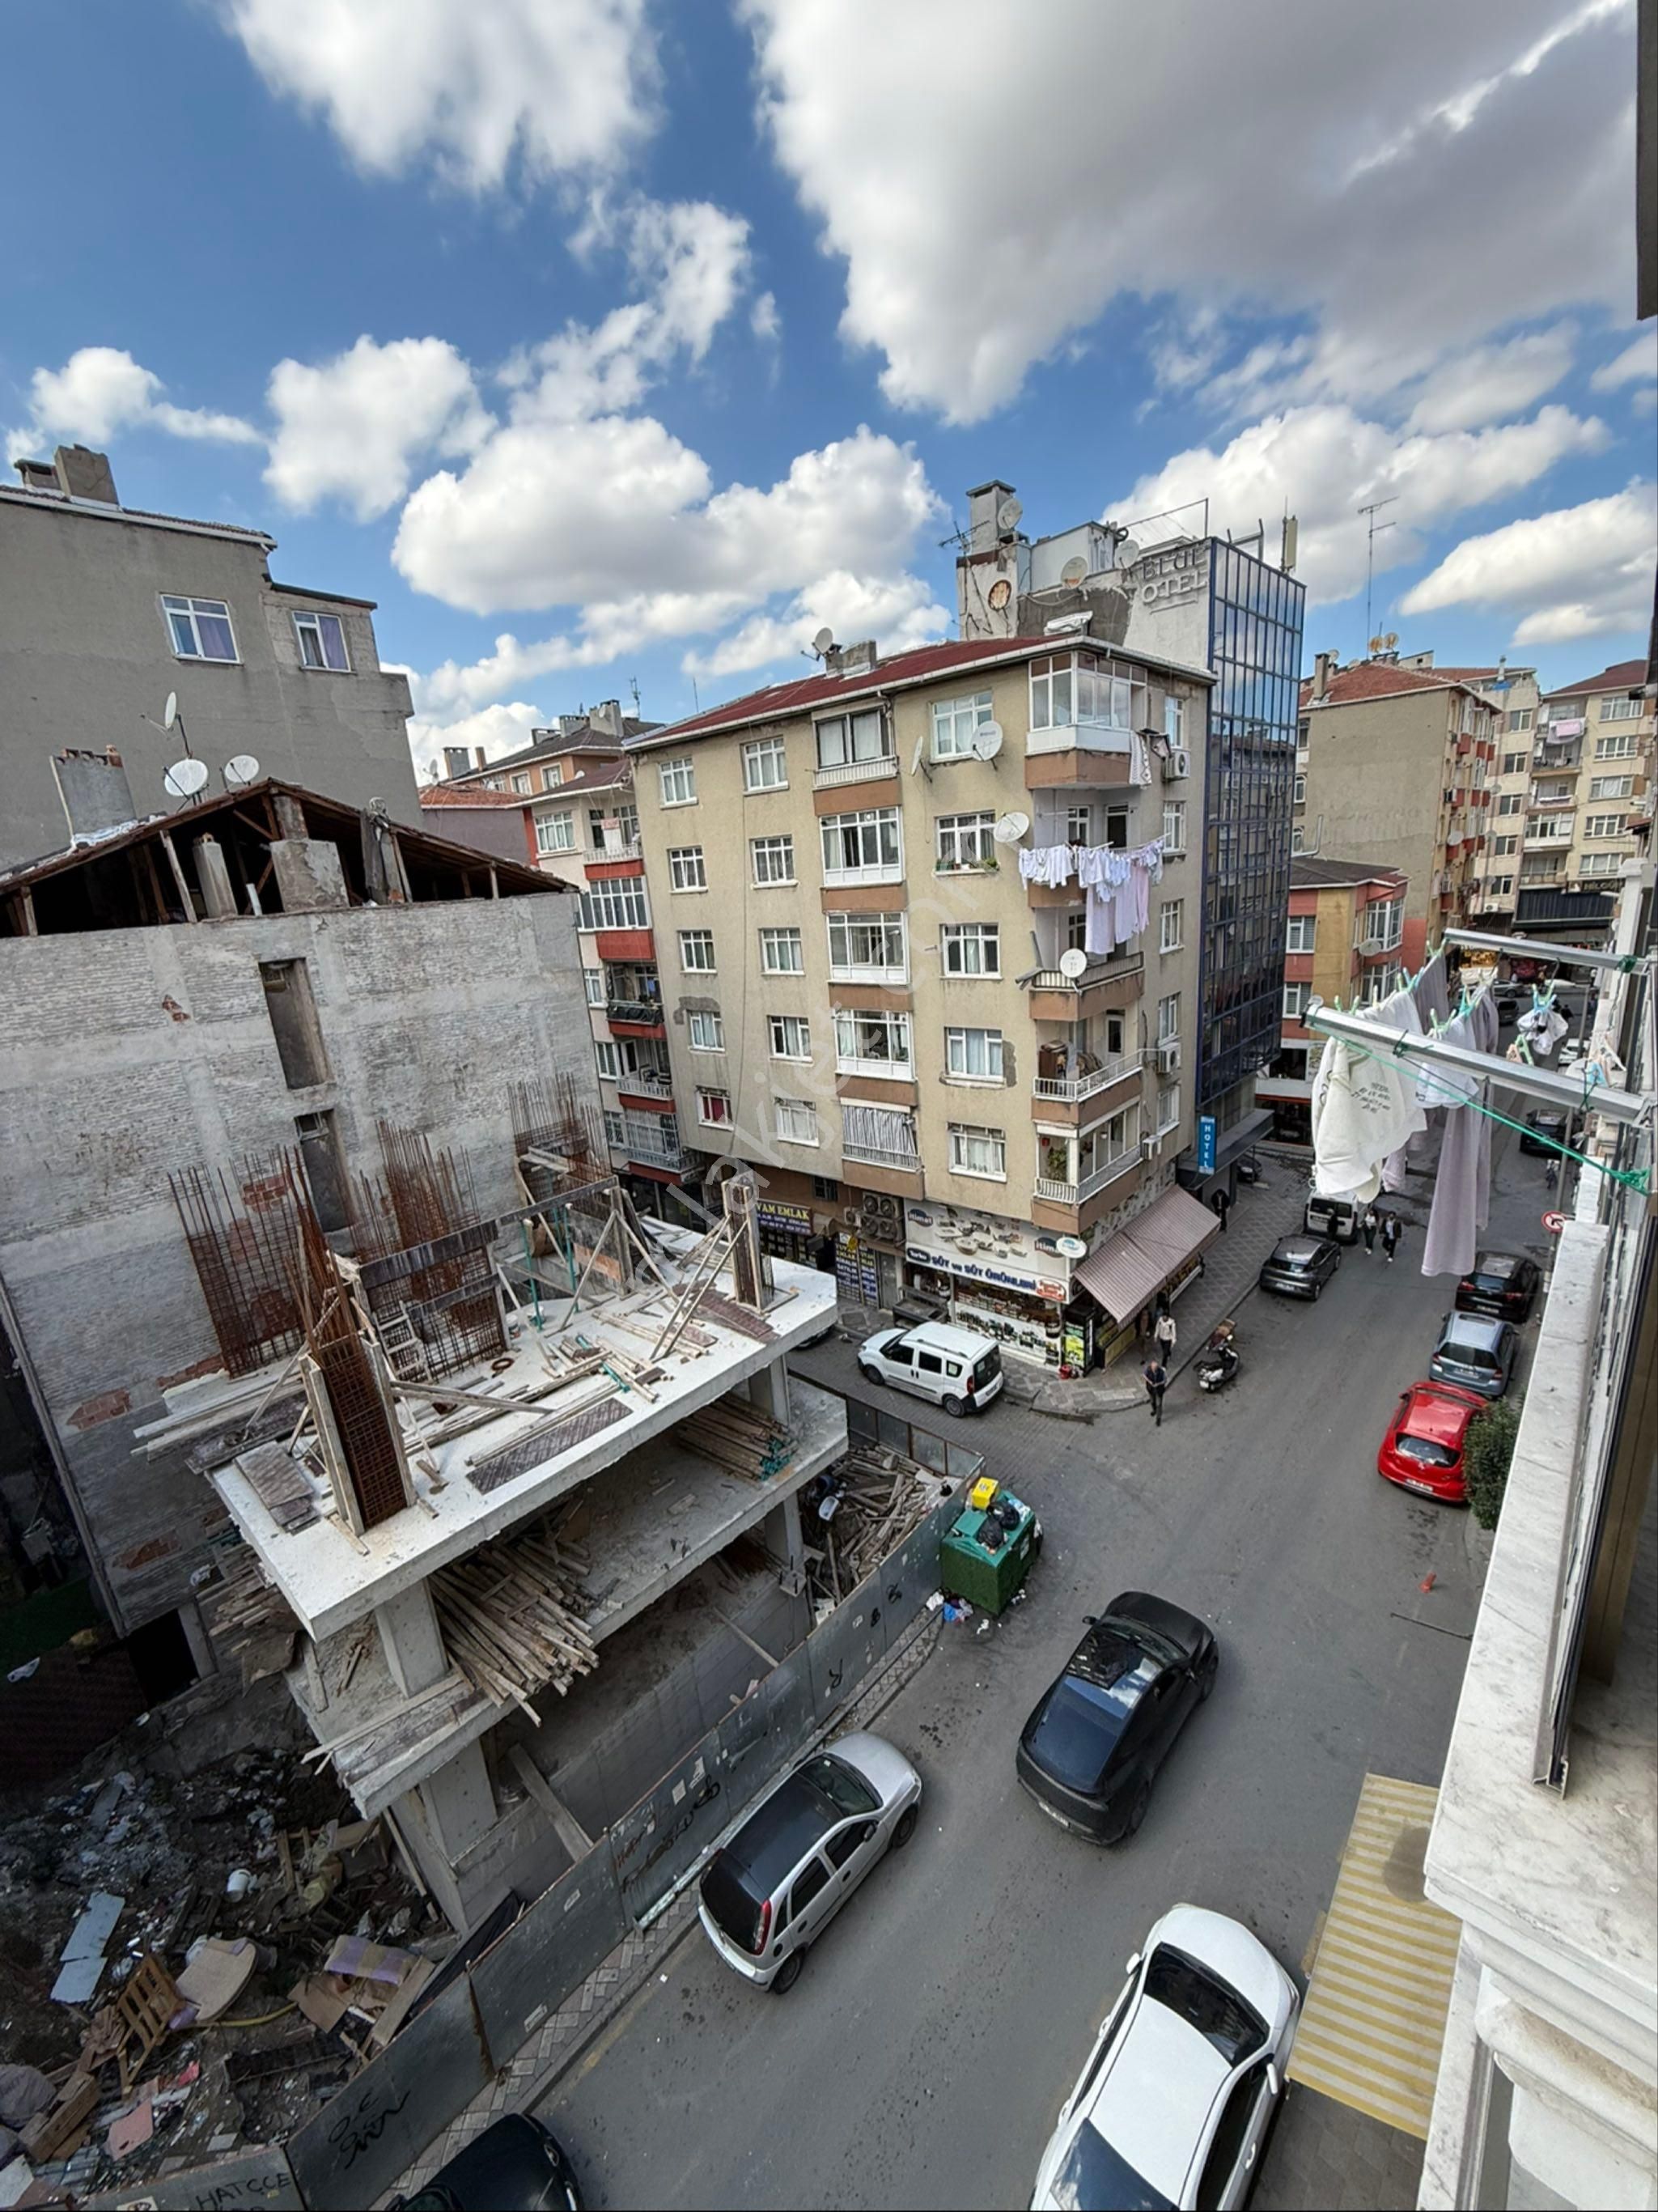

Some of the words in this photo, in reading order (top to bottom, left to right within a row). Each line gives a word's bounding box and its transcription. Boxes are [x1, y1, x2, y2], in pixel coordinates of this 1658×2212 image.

[1142, 570, 1206, 605] OTEL
[1203, 1124, 1212, 1168] HOTEL
[777, 1205, 809, 1221] EMLAK
[931, 1255, 949, 1268] SÜT
[964, 1263, 983, 1277] SÜT
